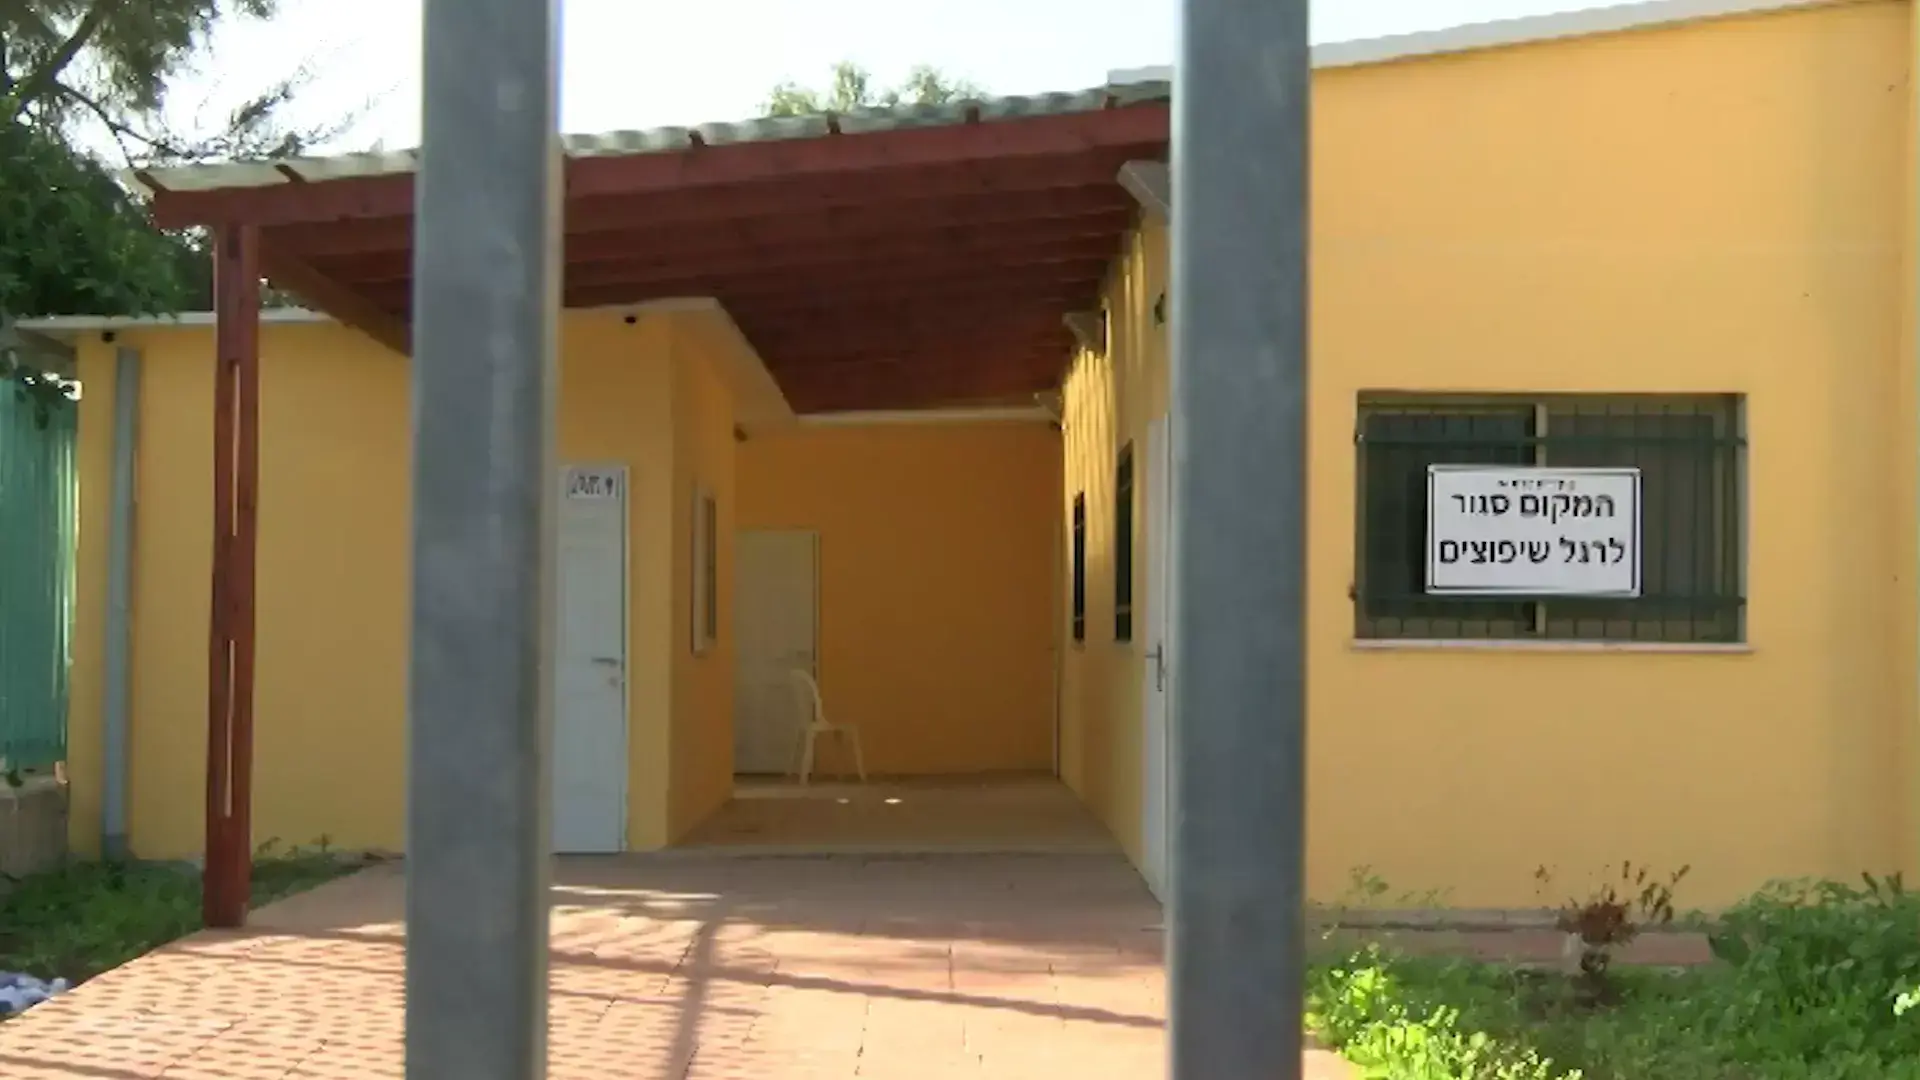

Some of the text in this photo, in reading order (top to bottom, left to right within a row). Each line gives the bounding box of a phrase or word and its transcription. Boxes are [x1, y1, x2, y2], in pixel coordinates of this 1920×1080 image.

[1451, 494, 1615, 524] המקום סגור
[1439, 535, 1625, 564] לרגל שיפוצים
